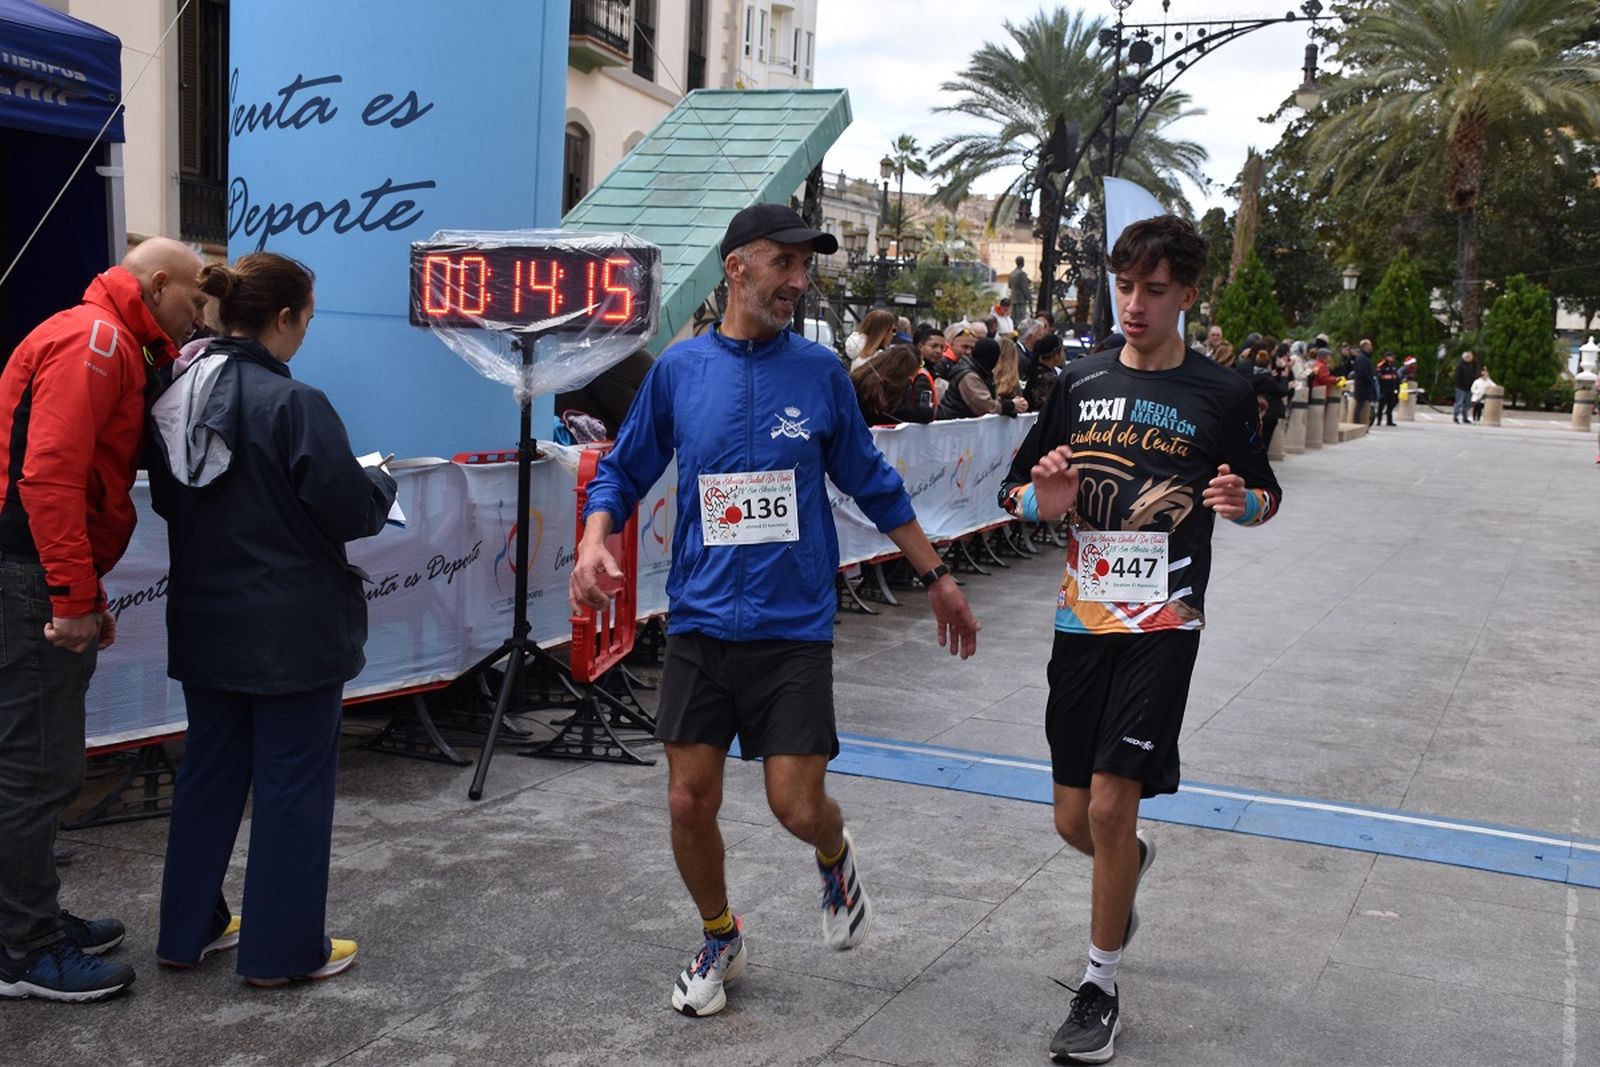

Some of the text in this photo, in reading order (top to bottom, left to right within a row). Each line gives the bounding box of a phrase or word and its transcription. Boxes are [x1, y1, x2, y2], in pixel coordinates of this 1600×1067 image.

[361, 90, 434, 128] es
[228, 176, 437, 252] Deporte
[424, 255, 632, 320] 00:14:15
[1078, 397, 1127, 422] XXXII
[1130, 411, 1197, 437] MARATÓN
[1134, 398, 1178, 420] MEDIA
[1070, 422, 1191, 457] ciudad de Ceuta
[742, 496, 788, 520] 136
[404, 572, 422, 588] es
[427, 540, 482, 585] Deporte
[1111, 556, 1159, 579] 447
[107, 574, 169, 622] eport
